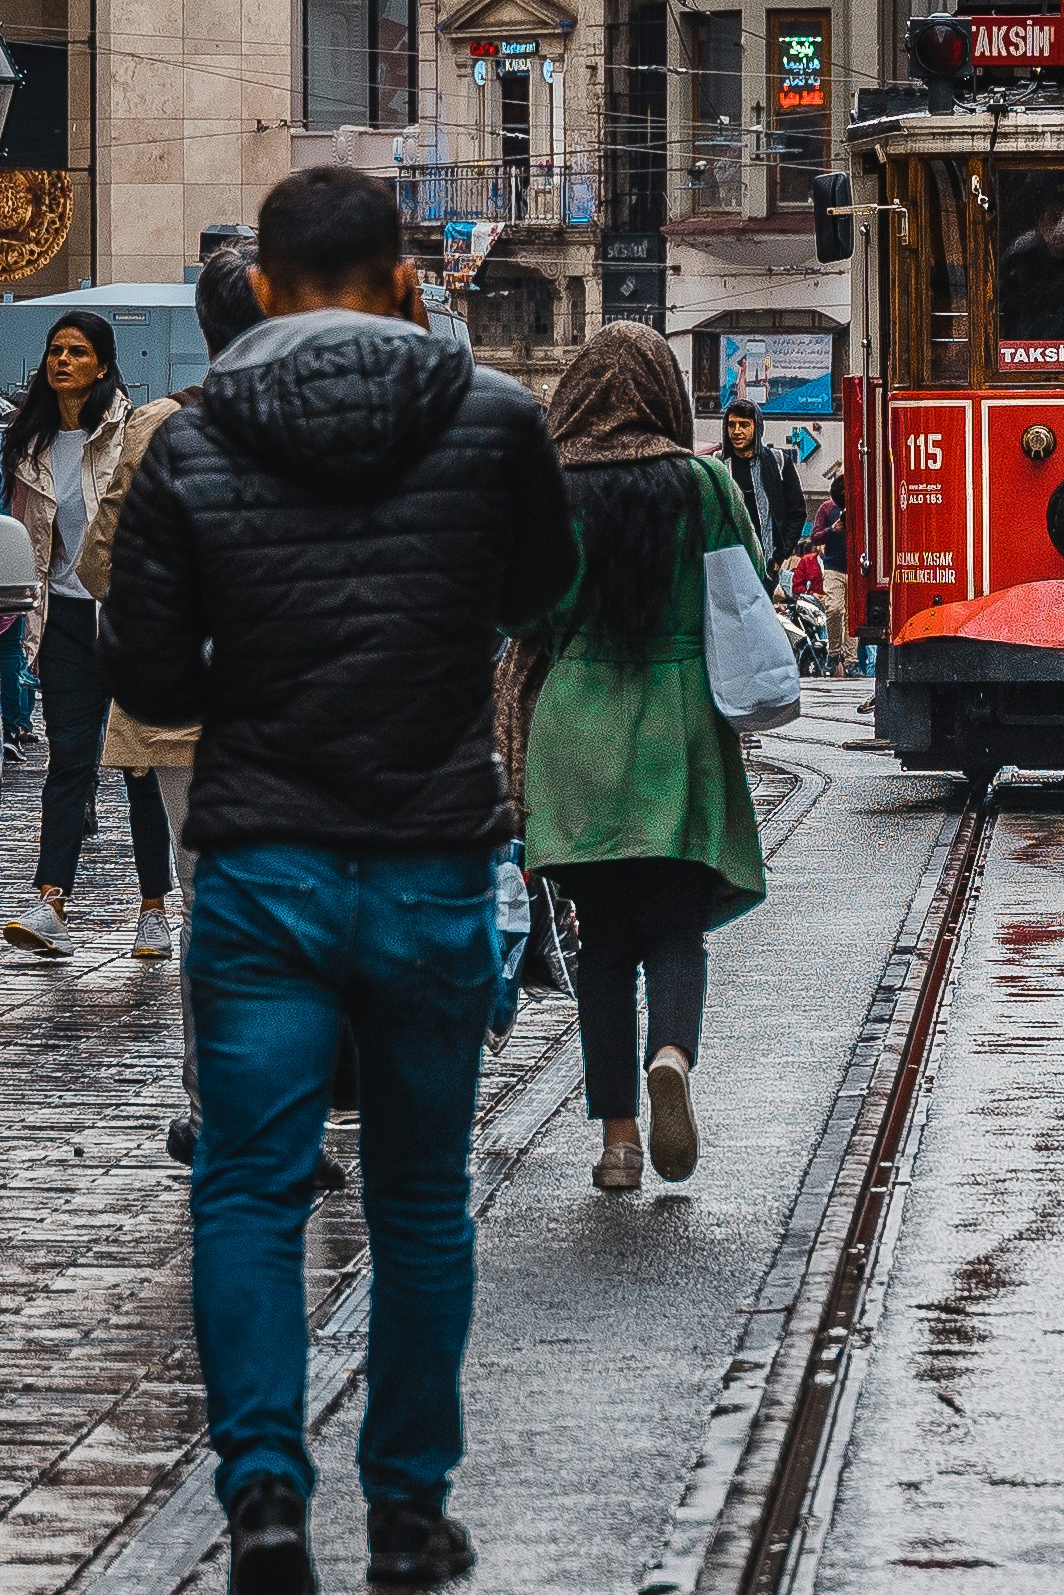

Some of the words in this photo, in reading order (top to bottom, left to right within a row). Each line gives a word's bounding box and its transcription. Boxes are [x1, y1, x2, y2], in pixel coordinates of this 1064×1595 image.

[972, 20, 1050, 57] AKSİM
[906, 433, 943, 471] 115
[923, 551, 954, 566] YASAK
